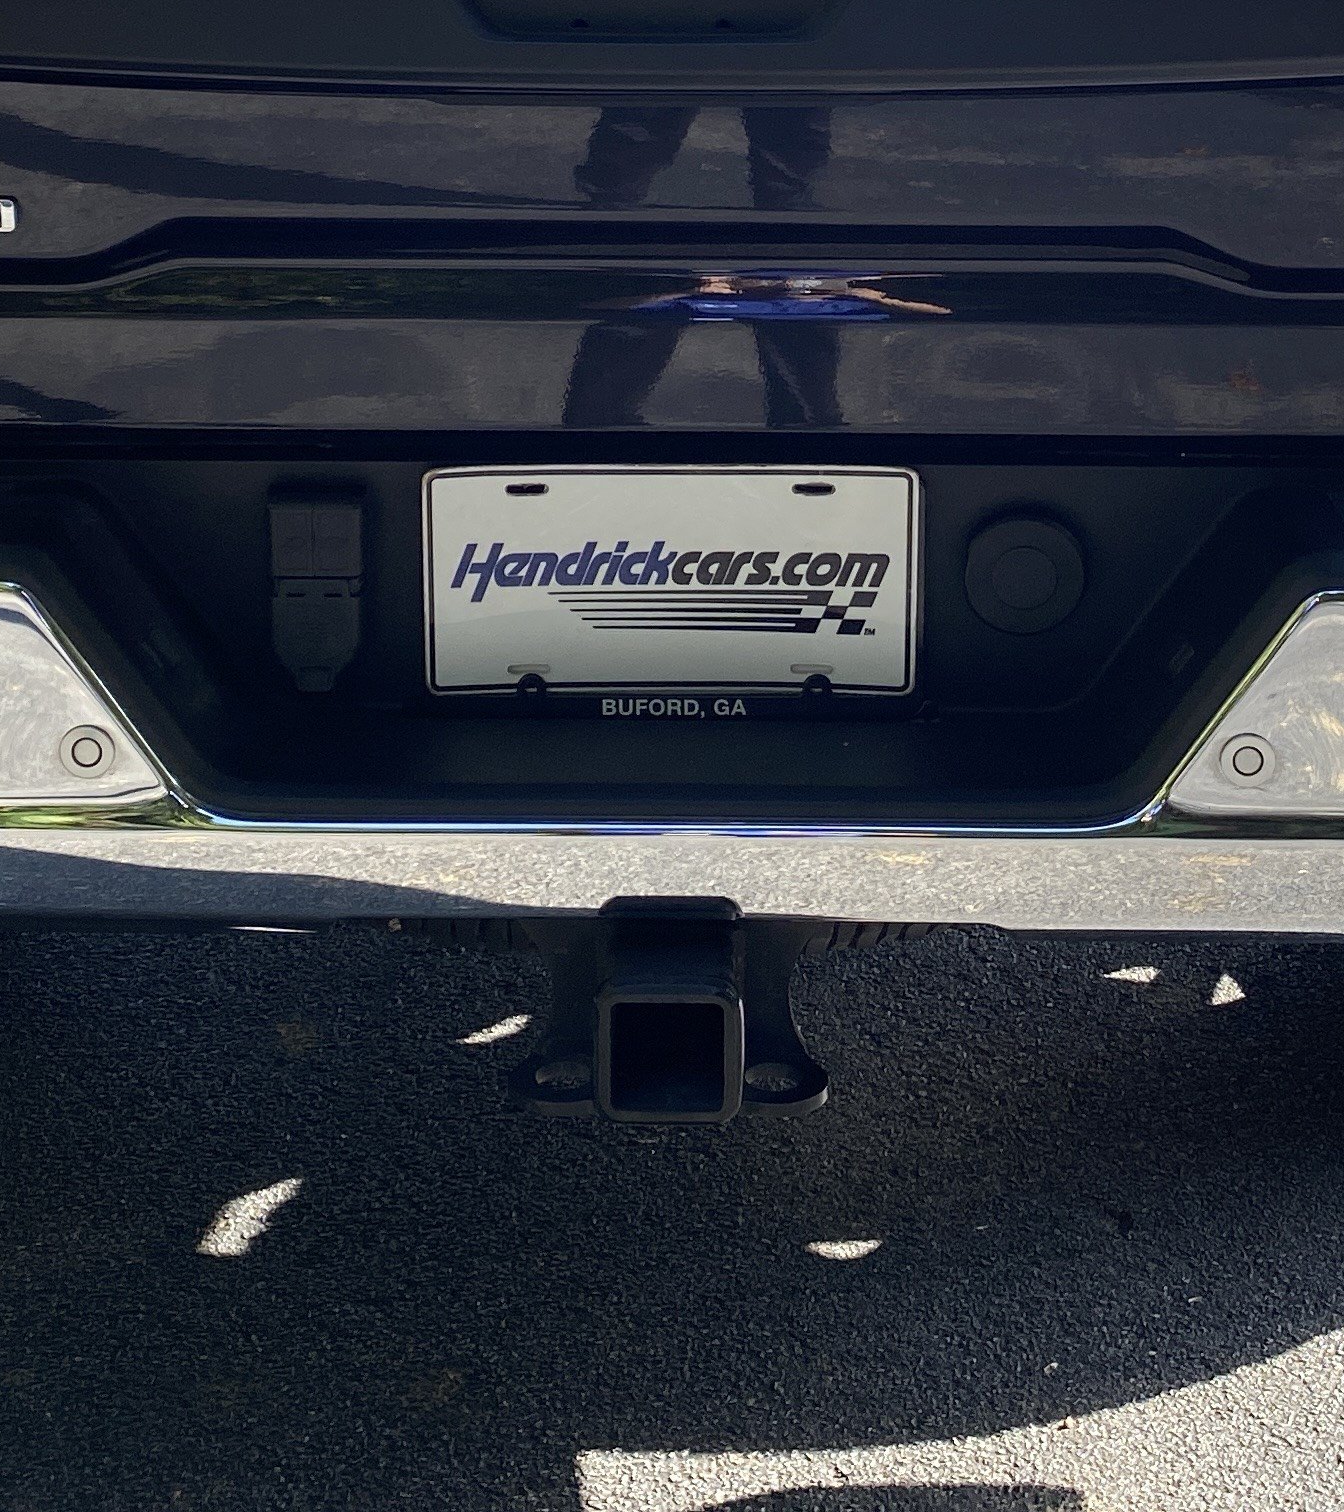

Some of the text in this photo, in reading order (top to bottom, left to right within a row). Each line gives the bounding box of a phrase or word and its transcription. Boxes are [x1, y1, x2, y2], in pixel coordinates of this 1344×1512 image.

[450, 540, 891, 603] Hendrickcars.com
[601, 698, 747, 719] BUFORD, GA
